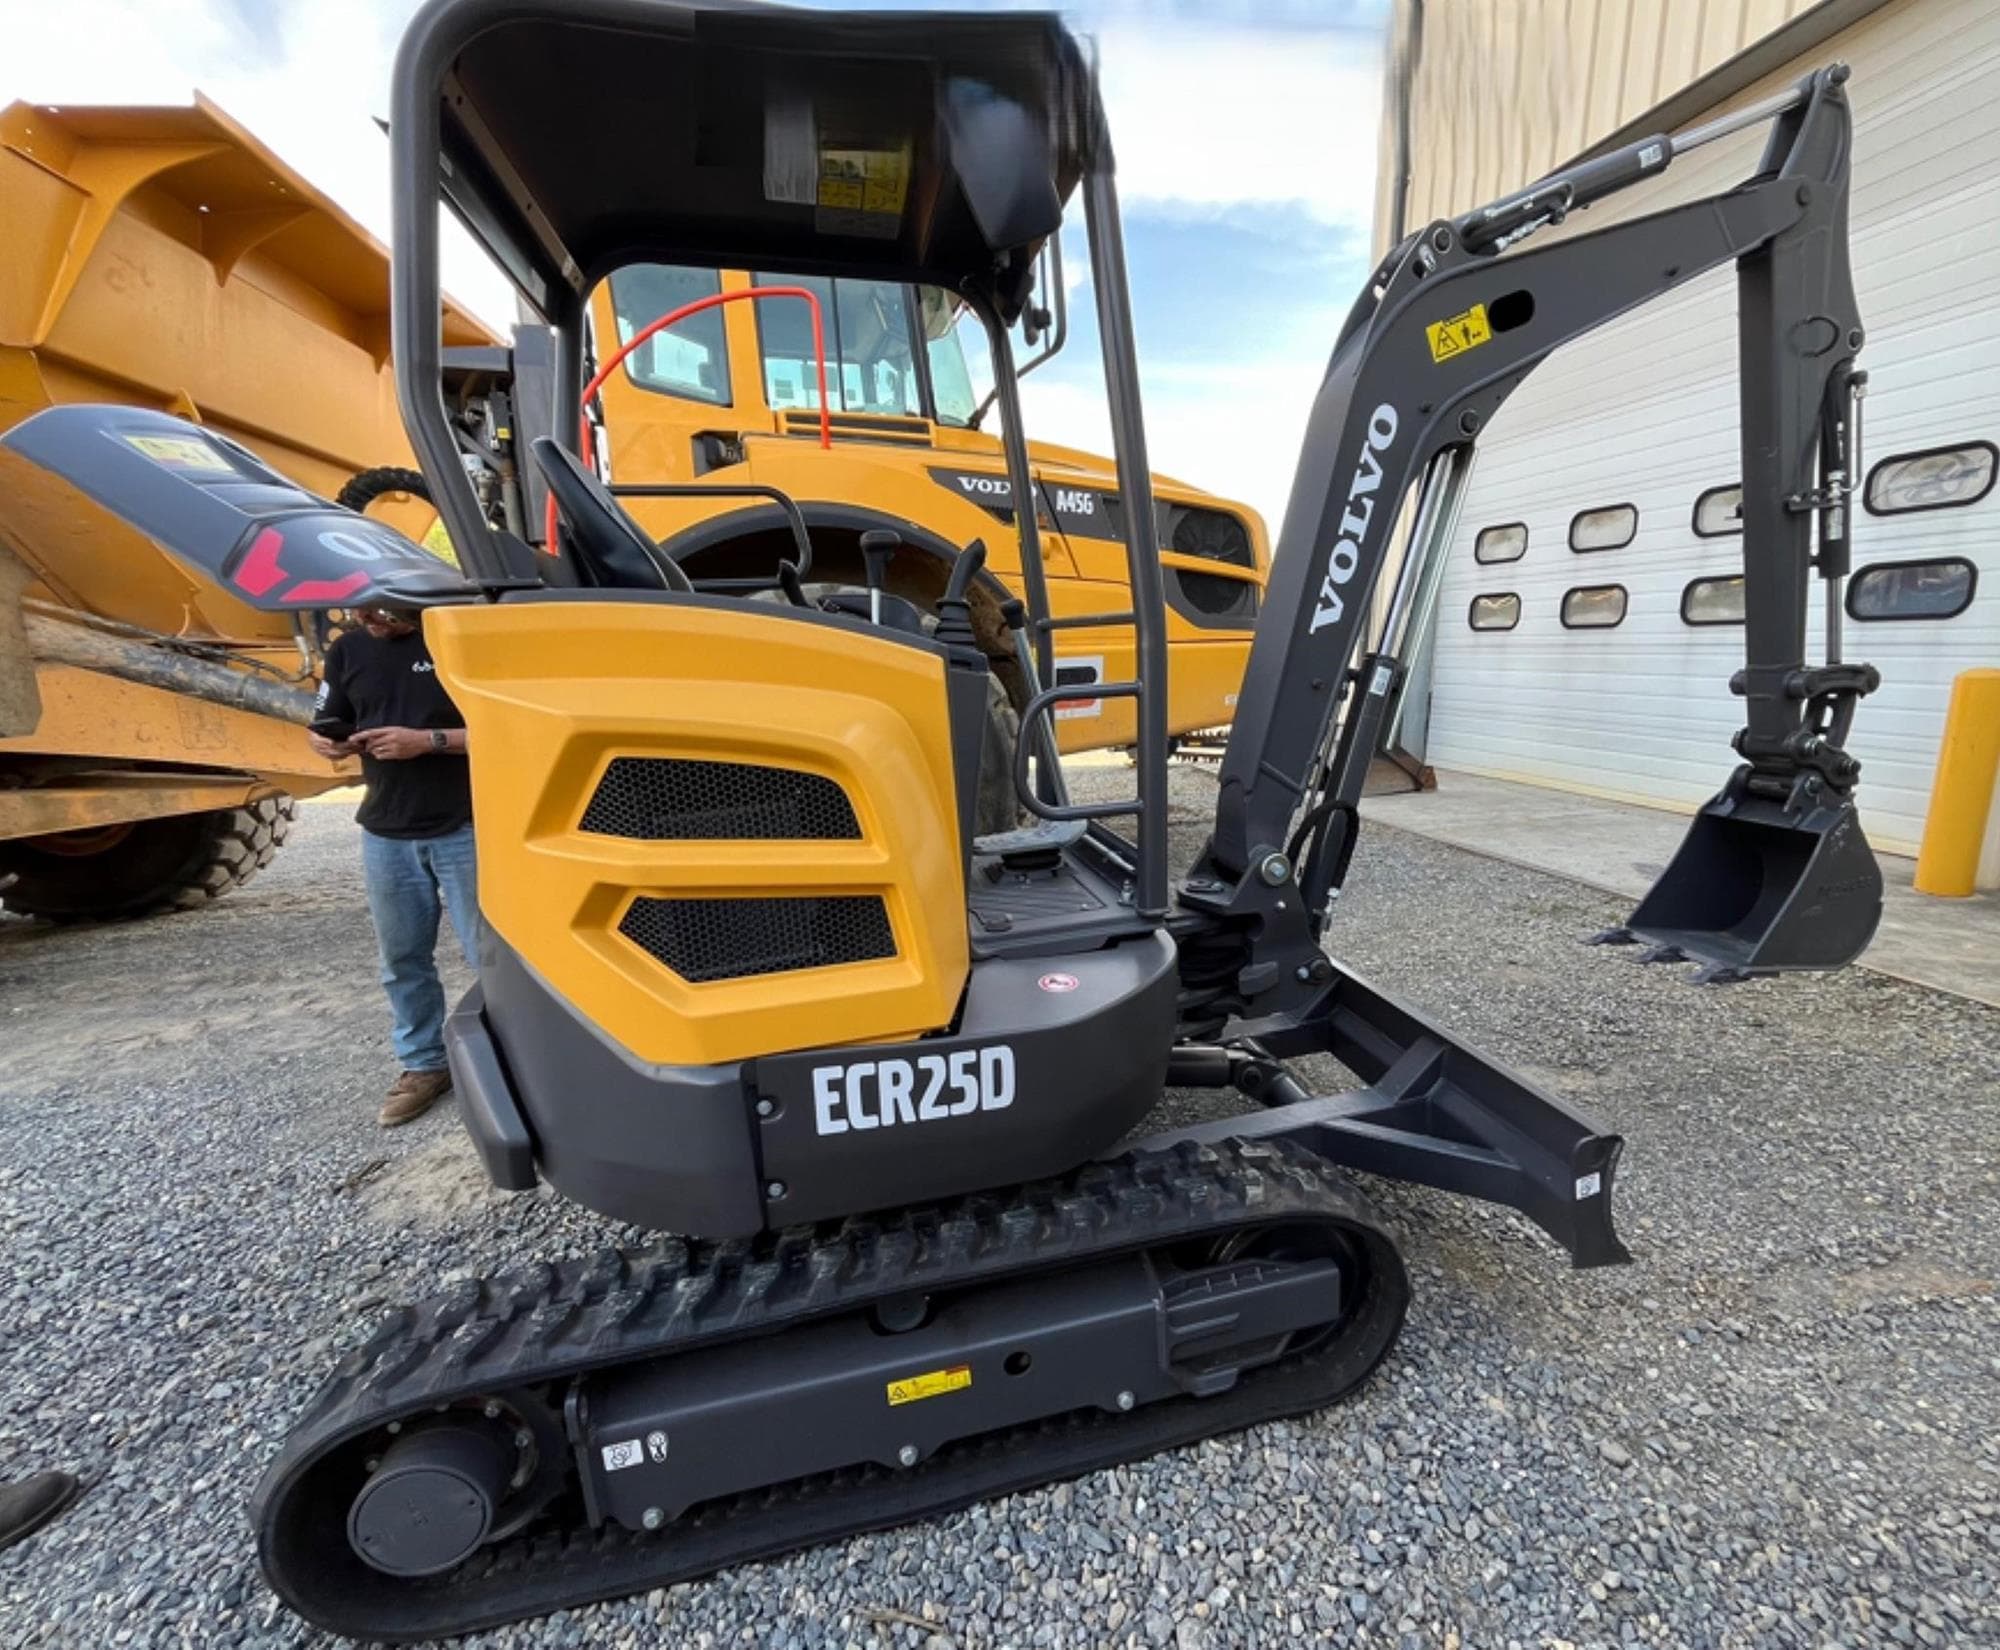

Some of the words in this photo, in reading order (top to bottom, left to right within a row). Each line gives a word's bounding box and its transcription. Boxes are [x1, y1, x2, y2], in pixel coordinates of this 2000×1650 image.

[957, 476, 1037, 497] VOL
[1056, 489, 1095, 515] A45G
[1309, 403, 1398, 635] VOLVO
[812, 1045, 1016, 1136] ECR25D
